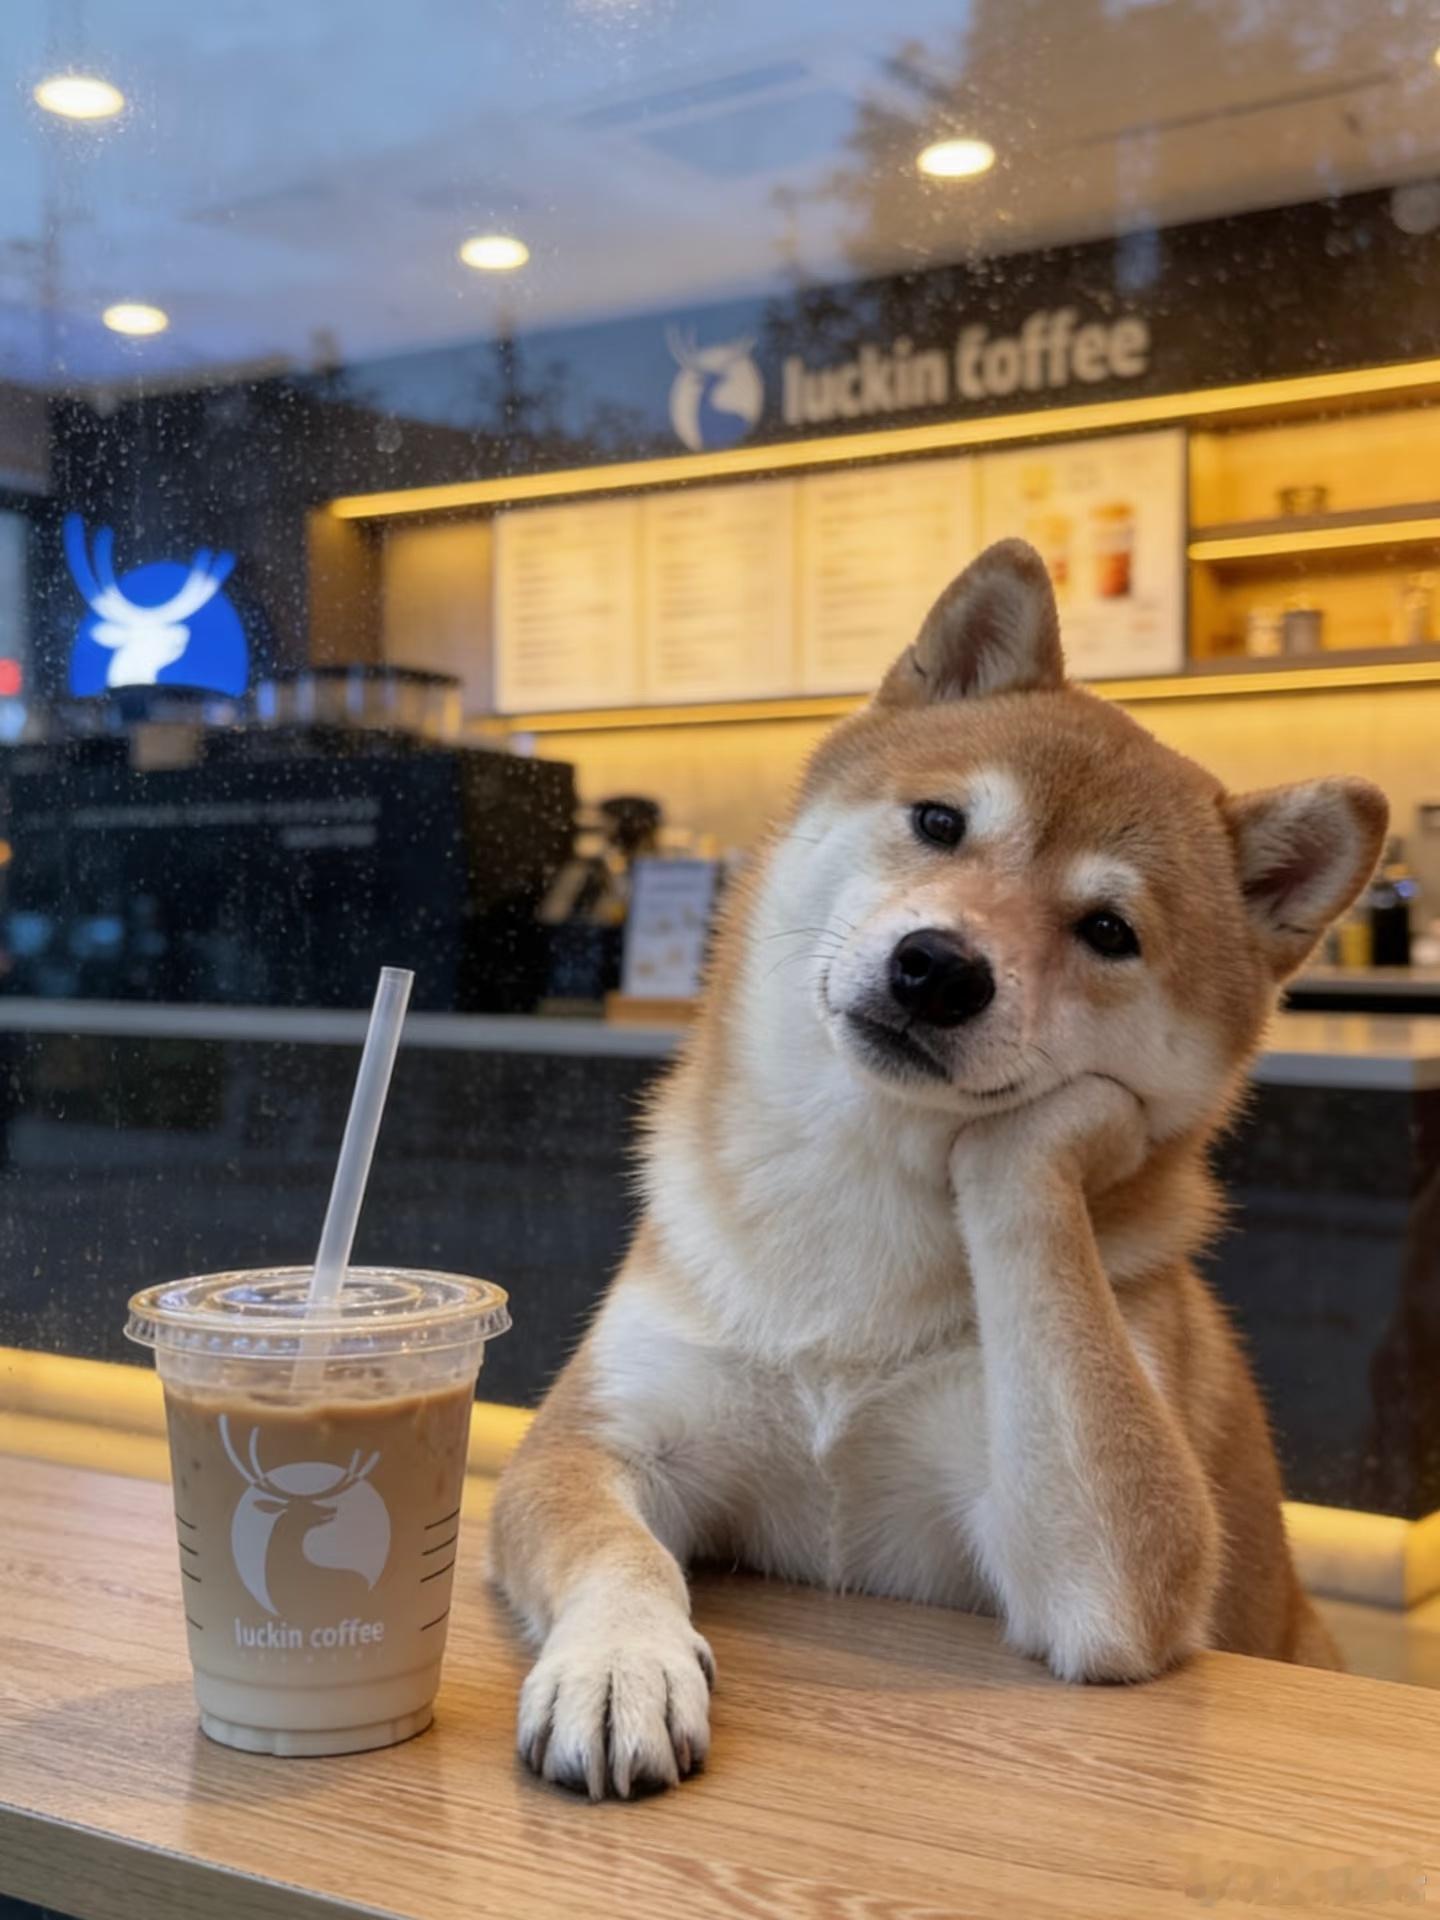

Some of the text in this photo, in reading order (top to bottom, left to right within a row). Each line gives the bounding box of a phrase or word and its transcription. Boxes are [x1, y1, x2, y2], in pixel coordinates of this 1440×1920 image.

[783, 341, 946, 425] luckin
[233, 1617, 385, 1649] luckin coffee
